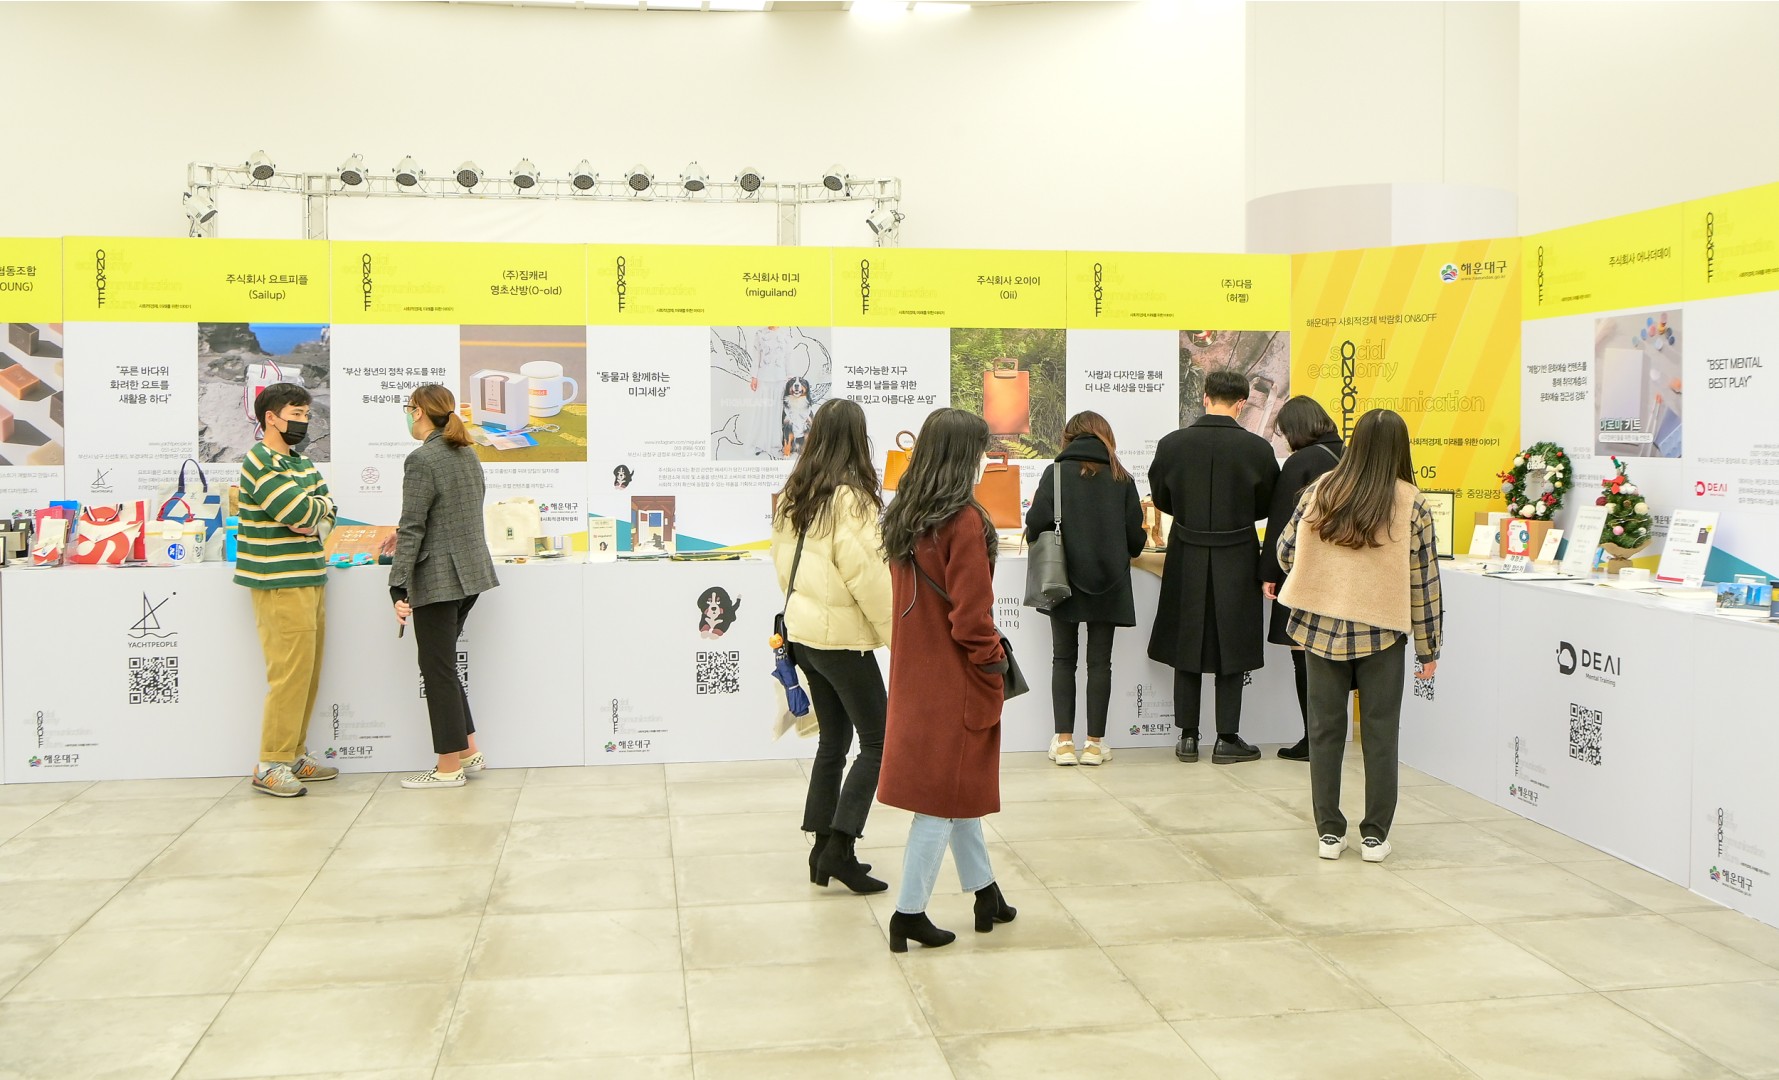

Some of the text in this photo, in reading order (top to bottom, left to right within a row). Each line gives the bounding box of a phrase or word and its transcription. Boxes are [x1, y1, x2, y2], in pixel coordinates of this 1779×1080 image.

[1608, 247, 1671, 268] 주식회사 어나더데이
[1460, 260, 1507, 276] 해운대구
[96, 249, 106, 307] ON&OFF
[225, 272, 309, 286] 주식회사 요트피플
[502, 269, 548, 281] (주)짐캐리
[742, 272, 779, 283] 주식회사
[976, 275, 1041, 286] 주식회사 오이이
[361, 253, 372, 311] ON&OFF
[616, 255, 626, 313] ON&OFF
[860, 259, 870, 315] ON&OFF
[248, 289, 286, 301] (Sailup)
[745, 287, 797, 299] (miguiland)
[1093, 263, 1103, 317] ON&OFF
[1306, 313, 1437, 328] 해운대구 사회적경제 박람회 ON&OFF
[1730, 356, 1763, 369] MENTAL
[140, 365, 169, 377] 바다위
[363, 366, 387, 377] 청년의
[388, 367, 403, 377] 정착
[405, 366, 429, 377] 유도를
[430, 366, 446, 377] 위한
[890, 365, 908, 376] 지구
[1113, 370, 1145, 380] 디자인을
[1146, 370, 1163, 380] 통해
[631, 371, 671, 383] 함께하는
[1708, 377, 1728, 389] BEST
[110, 379, 170, 391] 화려한 요트를
[380, 380, 420, 390] 원도심에서
[846, 380, 917, 391] 보통의 날들을 위한
[1085, 383, 1093, 393] 더
[1094, 383, 1111, 393] 나은
[1112, 383, 1136, 393] 세상을
[119, 393, 148, 405] 새활용
[881, 394, 915, 405] 아름다운
[1559, 391, 1575, 402] 접근성
[1622, 417, 1642, 430] 키트
[1443, 438, 1463, 446] 미래를
[1464, 438, 1478, 447] 위한
[1479, 438, 1500, 446] 이야기
[1420, 465, 1437, 479] 05
[1707, 482, 1728, 492] DEAI
[1466, 488, 1501, 499] 중앙광장
[550, 502, 578, 511] 해운대구
[997, 597, 1020, 607] omg
[1581, 648, 1621, 676] DEAI
[1585, 673, 1616, 688] Mental Training
[1141, 723, 1172, 733] 해운대구
[338, 745, 374, 756] 해운대구
[618, 740, 651, 749] 해운대구
[44, 754, 80, 764] 해운대구
[1517, 785, 1539, 803] 해운대구
[1721, 868, 1754, 892] 해운대구
